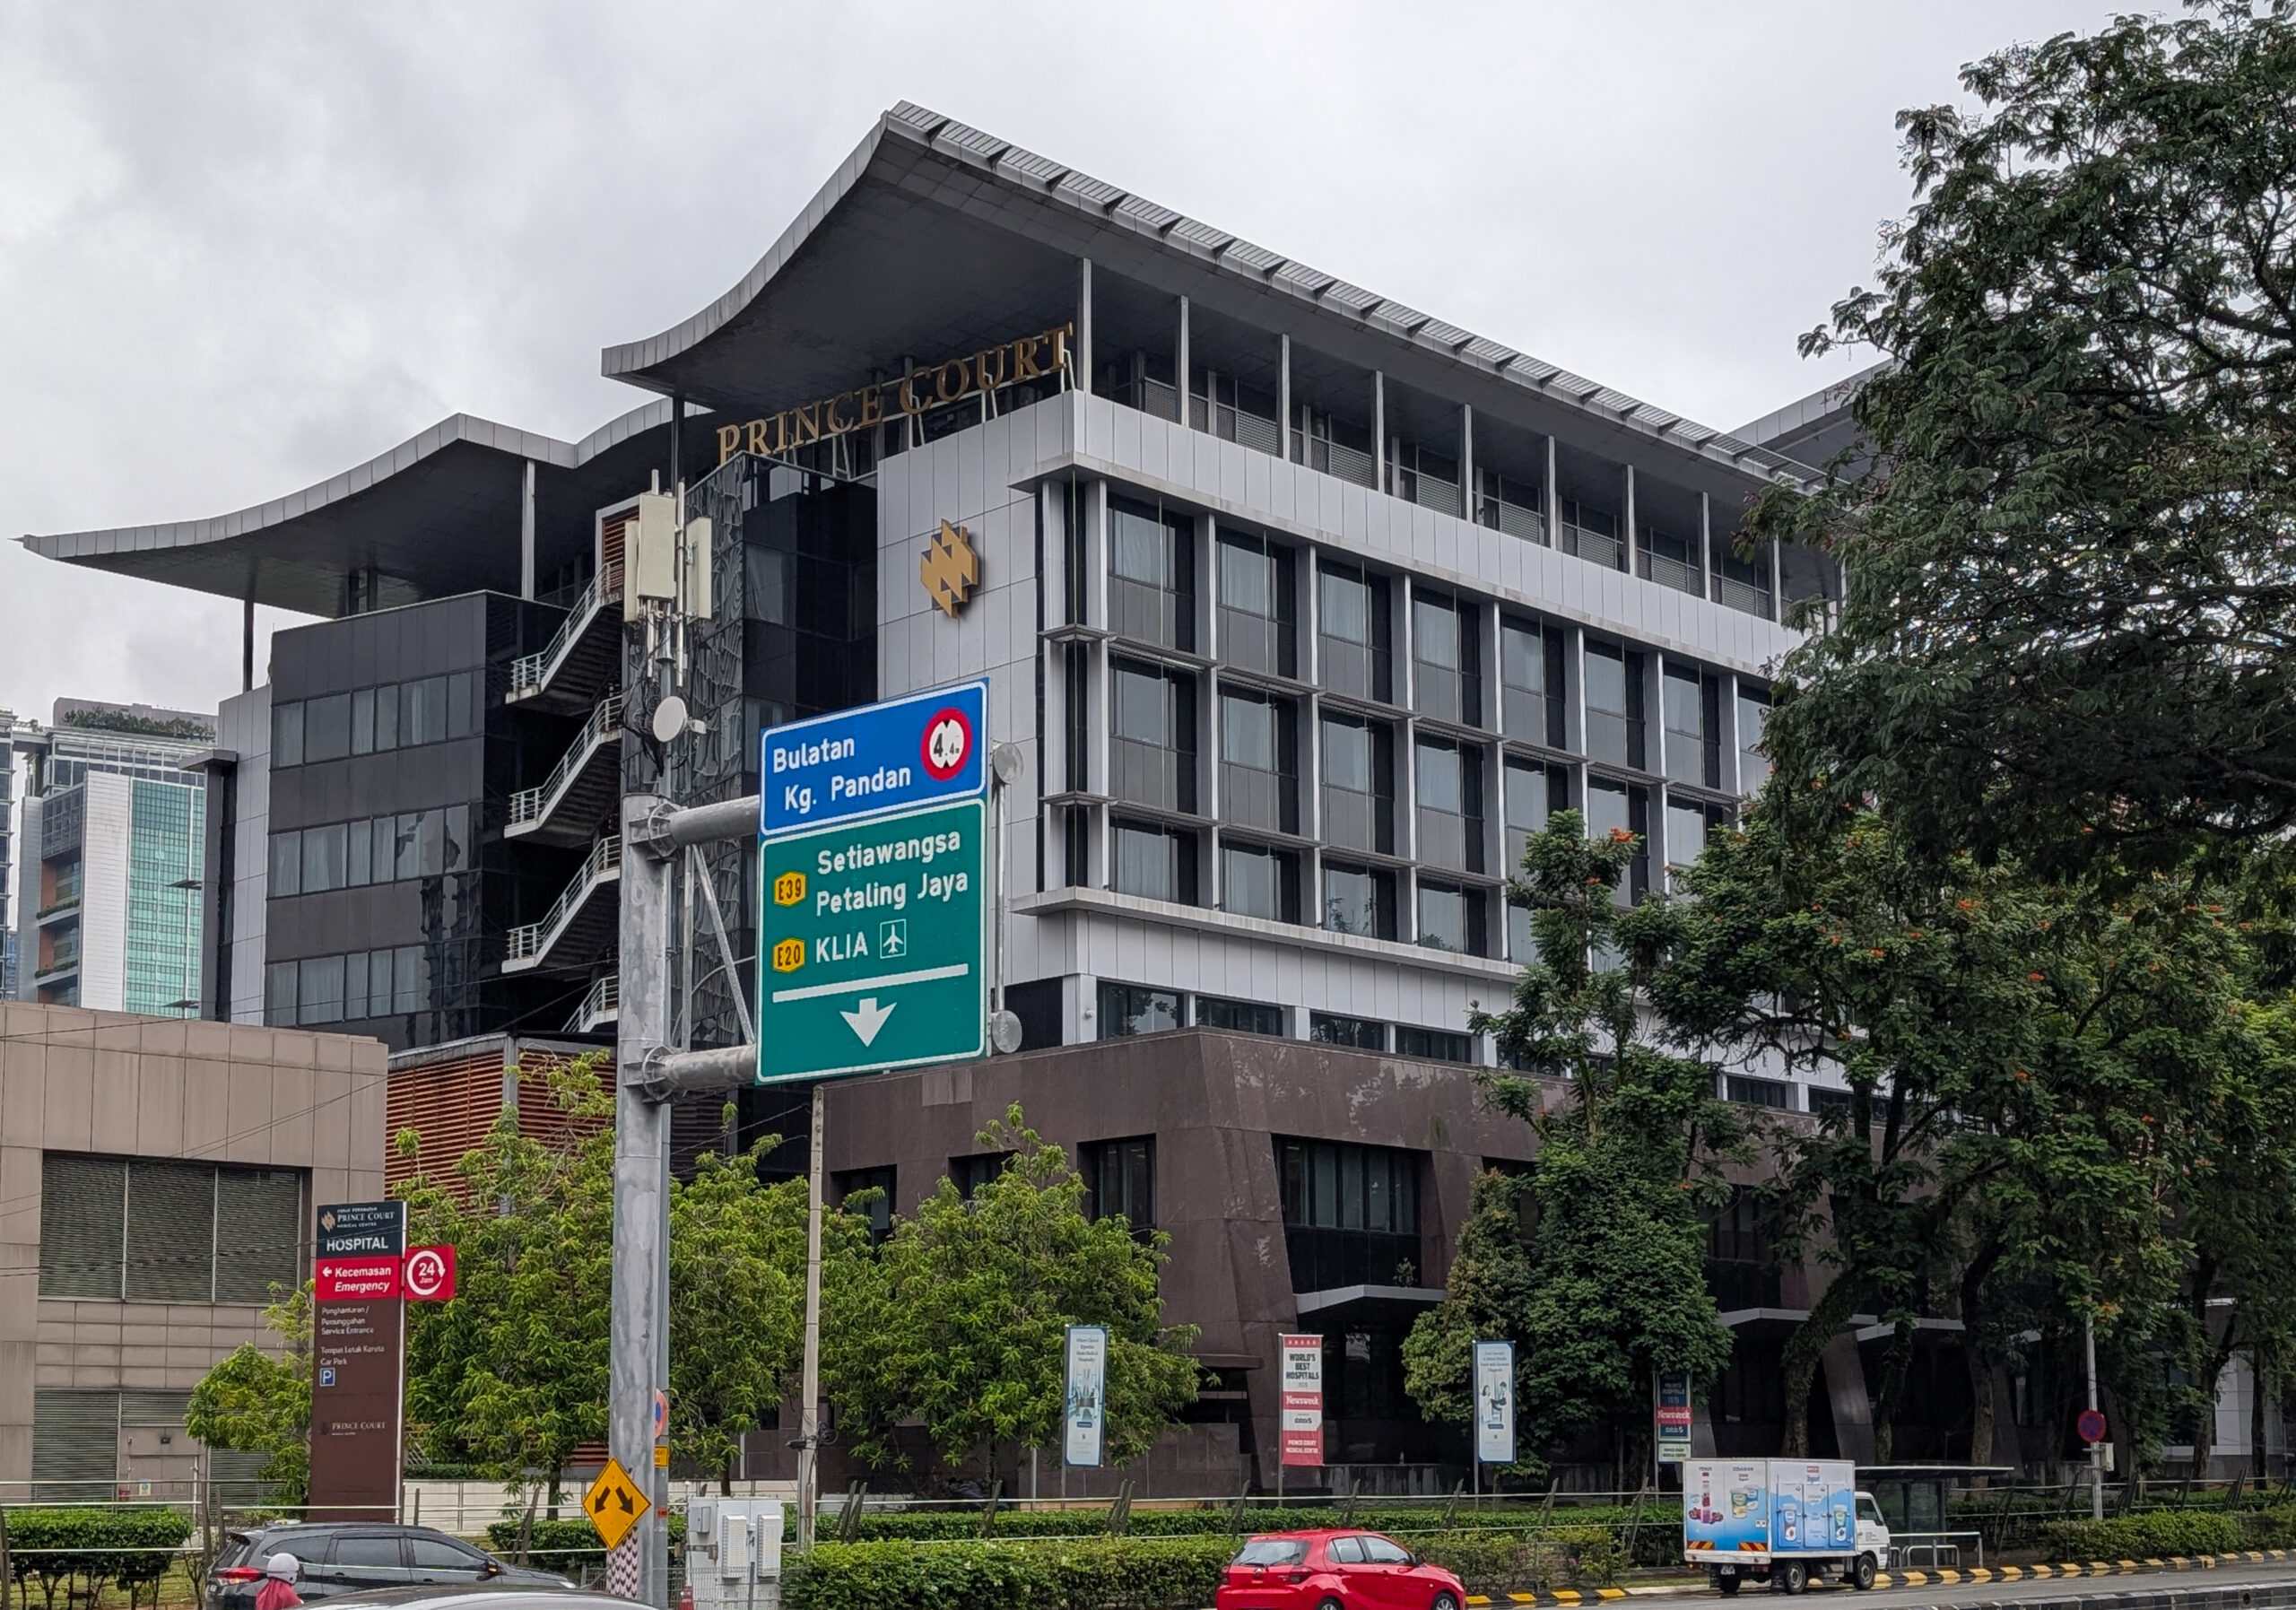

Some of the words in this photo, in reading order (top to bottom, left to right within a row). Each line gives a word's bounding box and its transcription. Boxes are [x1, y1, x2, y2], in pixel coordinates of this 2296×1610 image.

[716, 383, 884, 467] PRINCE
[900, 321, 1074, 414] COURT
[772, 737, 856, 774] Bulatan
[784, 785, 818, 815] Kg.
[831, 765, 911, 802] Pandan
[817, 831, 961, 876] Setiawangsa
[778, 876, 803, 901] E39
[816, 881, 907, 918] Petaling
[917, 870, 969, 904] Jaya
[815, 931, 868, 963] KLIA
[777, 943, 801, 968] E20
[337, 1214, 365, 1223] PRINCE
[368, 1212, 395, 1221] COURT
[326, 1237, 388, 1251] HOSPITAL
[335, 1266, 391, 1278] Kecemasan
[418, 1262, 435, 1276] 24
[420, 1276, 433, 1284] Jam
[335, 1282, 390, 1293] Emergency
[321, 1327, 344, 1336] Service
[346, 1326, 374, 1335] Entrance
[320, 1358, 332, 1366] Car
[333, 1357, 347, 1365] Park
[1289, 1353, 1316, 1362] WORLD'S
[1295, 1362, 1310, 1371] BEST
[1285, 1371, 1319, 1380] HOSPITALS
[1285, 1395, 1319, 1405] Newsweek
